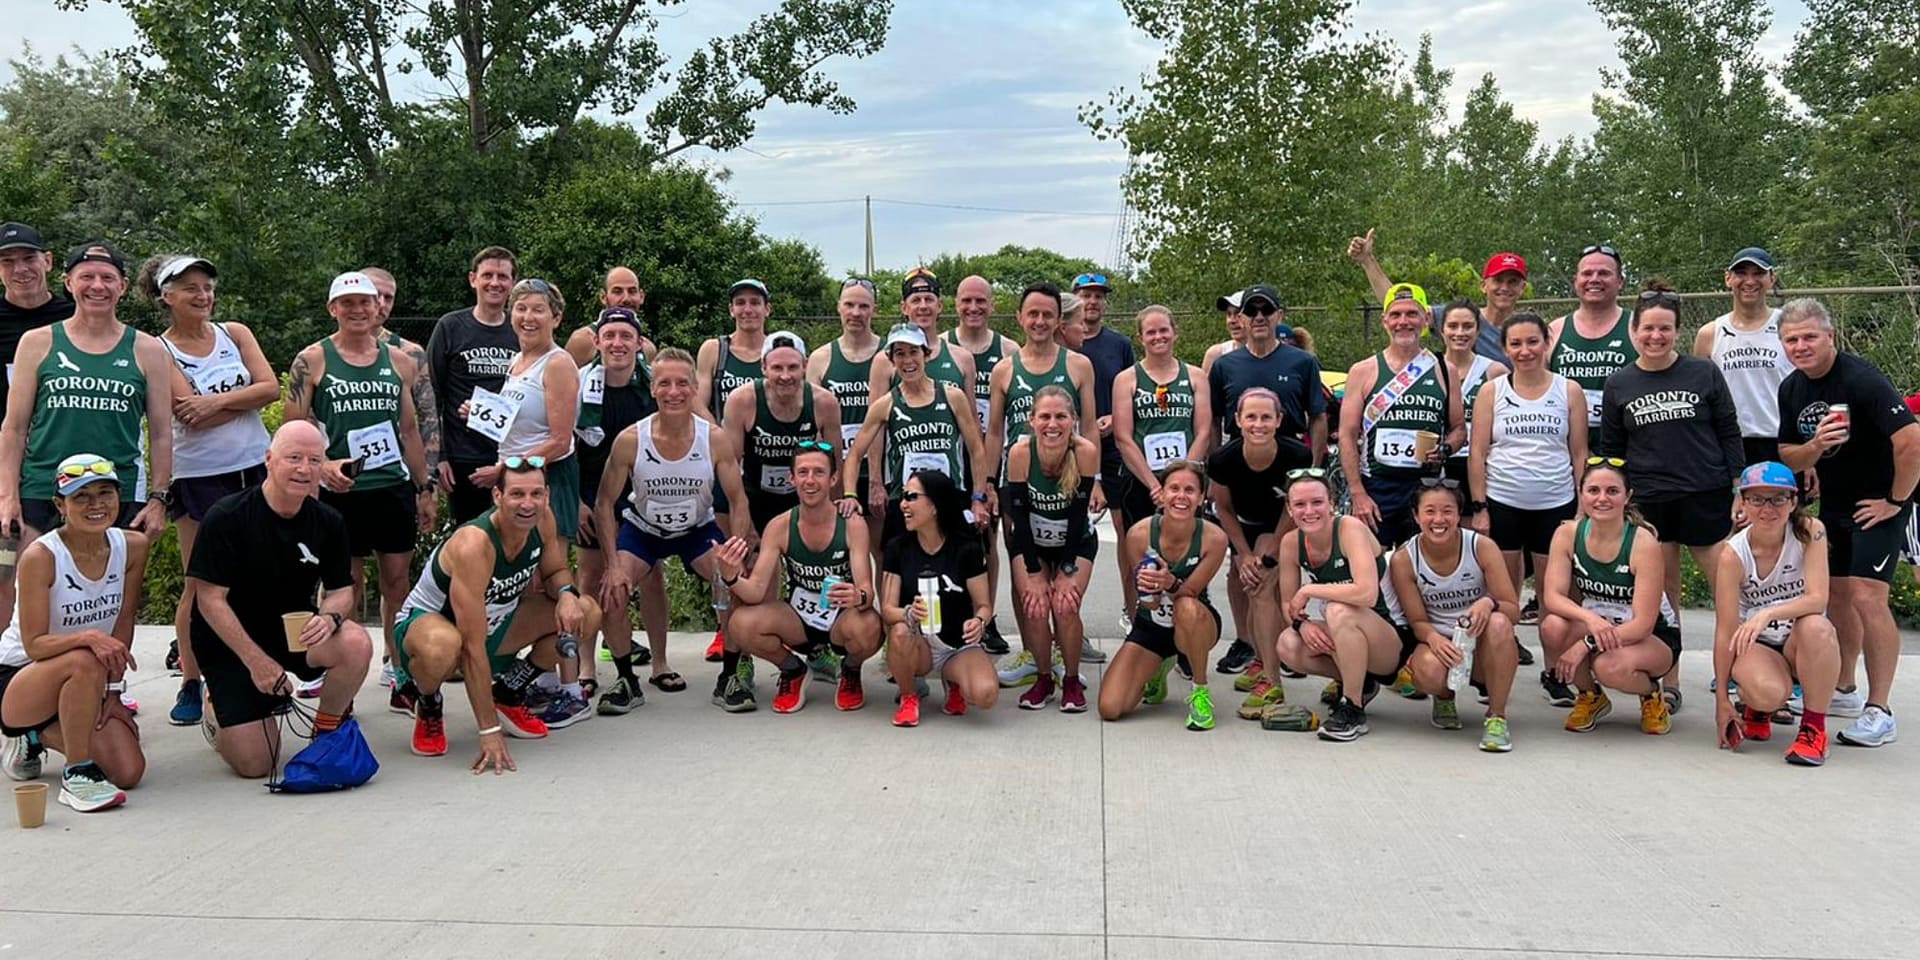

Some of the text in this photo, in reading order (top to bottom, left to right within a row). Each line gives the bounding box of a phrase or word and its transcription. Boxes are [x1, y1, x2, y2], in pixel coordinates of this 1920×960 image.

[460, 347, 518, 361] TORONT
[1558, 351, 1626, 365] TORONTO
[1722, 346, 1778, 361] TORONTO
[468, 364, 509, 375] HARRIE
[1723, 359, 1775, 371] HARRIERS
[45, 376, 135, 397] TORONTO
[325, 381, 400, 398] TORONTO
[829, 381, 870, 395] TORON
[47, 395, 129, 412] HARRIERS
[332, 399, 399, 414] HARRIERS
[1394, 393, 1443, 410] RONTO
[1626, 390, 1699, 414] TORONTO
[470, 403, 508, 429] 36-3
[1503, 413, 1561, 426] TORONTO
[1634, 407, 1696, 427] HARRIERS
[894, 422, 953, 442] TORONTO
[1505, 425, 1560, 435] HARRIERS
[360, 438, 390, 458] 33-1
[753, 435, 800, 447] TORON
[898, 439, 952, 456] HARRIERS
[1155, 446, 1181, 460] 11-1
[1381, 443, 1415, 457] 13-6
[644, 476, 703, 488] TORONTO
[768, 476, 792, 487] 12-
[647, 488, 700, 496] HARRIERS
[655, 512, 688, 524] 13-3
[1036, 527, 1067, 541] 12-5
[1577, 577, 1634, 597] ORONTO
[1743, 579, 1804, 599] TORONTO
[1424, 588, 1481, 602] TORONTO
